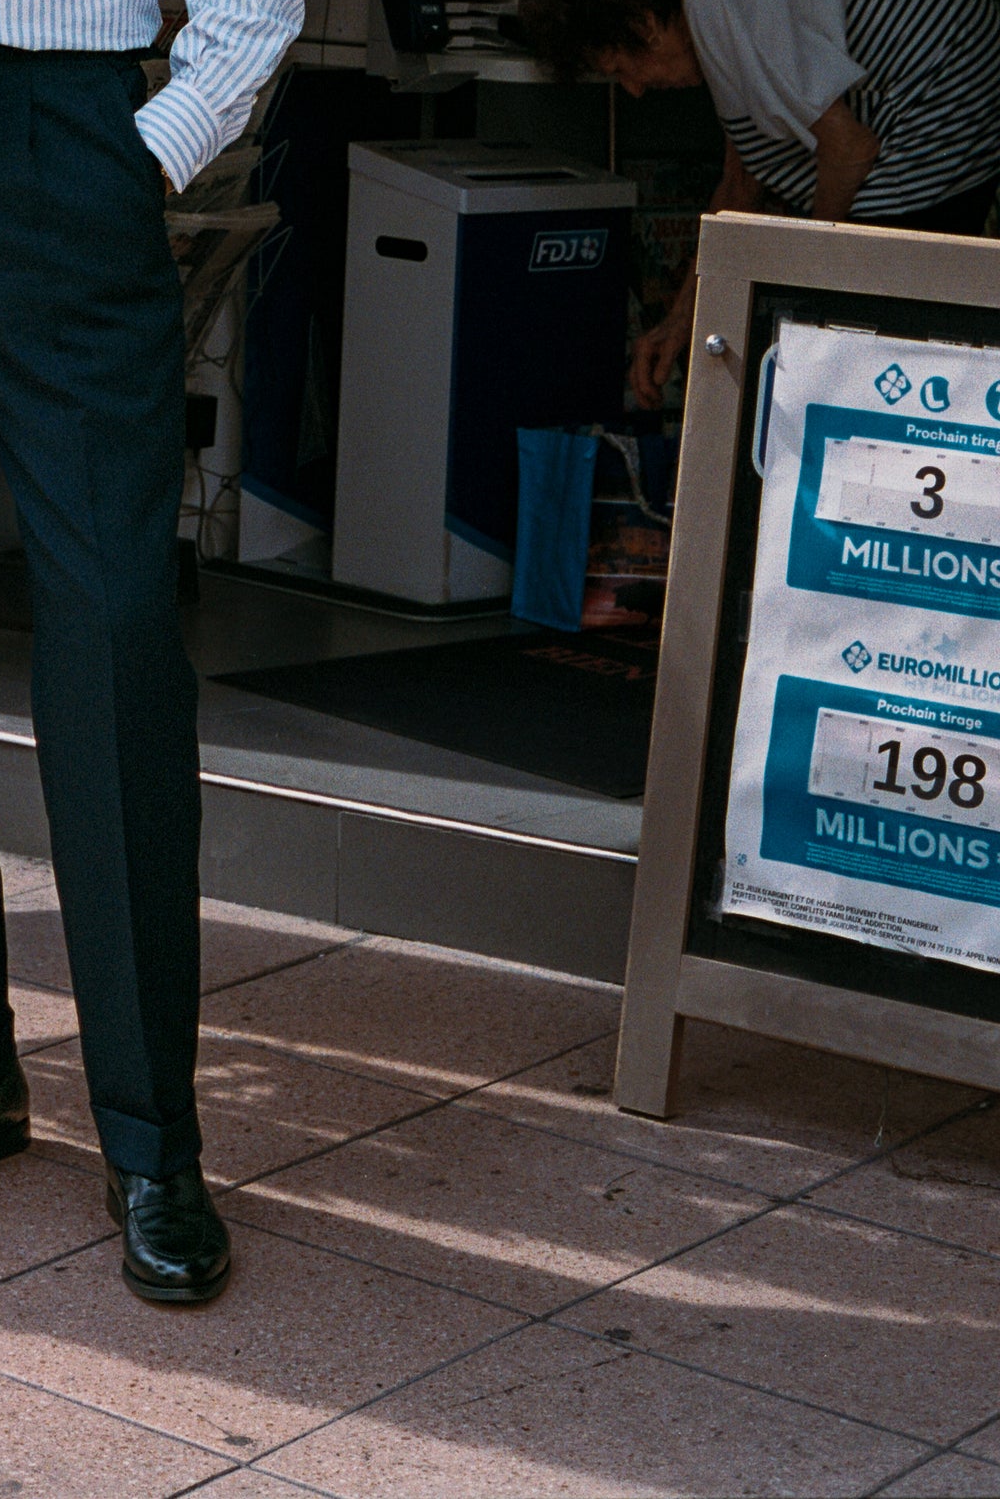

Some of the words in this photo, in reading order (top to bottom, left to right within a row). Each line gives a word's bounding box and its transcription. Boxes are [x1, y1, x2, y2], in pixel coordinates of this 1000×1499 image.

[535, 239, 578, 266] FDJ
[905, 423, 968, 446] Prochain
[910, 465, 946, 519] 3
[877, 698, 937, 722] Prochain
[939, 711, 983, 731] tirage
[873, 739, 988, 809] 198
[816, 807, 991, 871] MILLIONS
[790, 901, 824, 916] CONFLITS
[795, 893, 805, 903] ET
[806, 896, 816, 906] DE
[816, 898, 846, 912] HASARD
[897, 916, 939, 932] DANGEREUX
